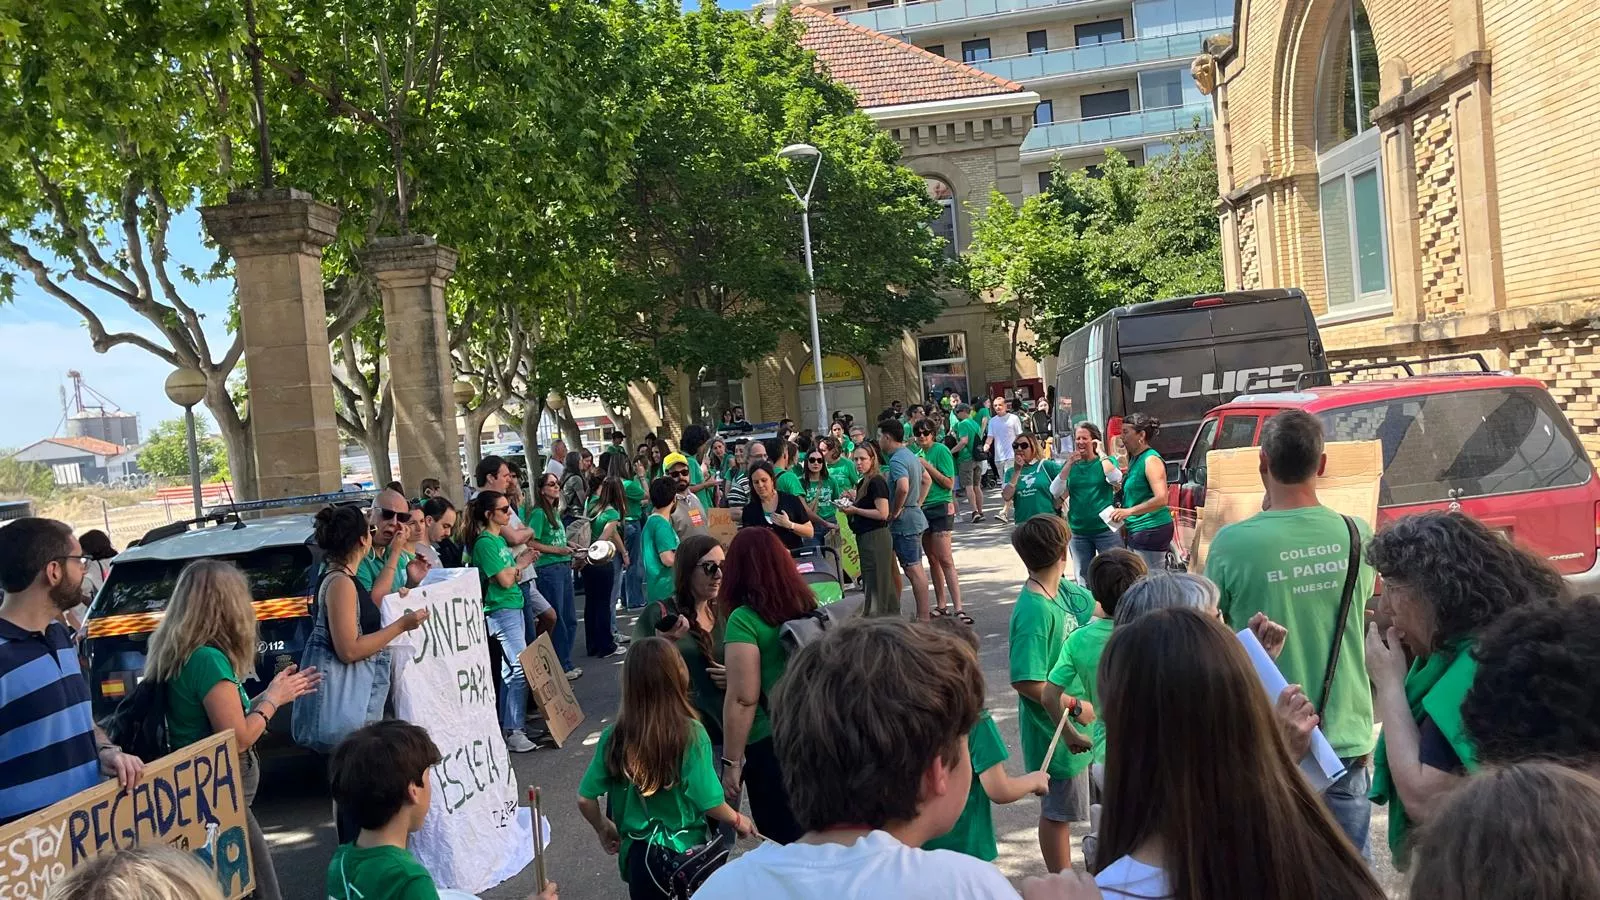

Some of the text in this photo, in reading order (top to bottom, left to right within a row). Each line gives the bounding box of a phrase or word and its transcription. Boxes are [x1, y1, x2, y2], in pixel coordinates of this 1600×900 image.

[1280, 543, 1341, 561] COLEGIO
[1266, 558, 1348, 583] EL PARQU
[1293, 580, 1338, 594] HUESCA
[267, 640, 284, 651] 112
[69, 741, 238, 868] REGADERA
